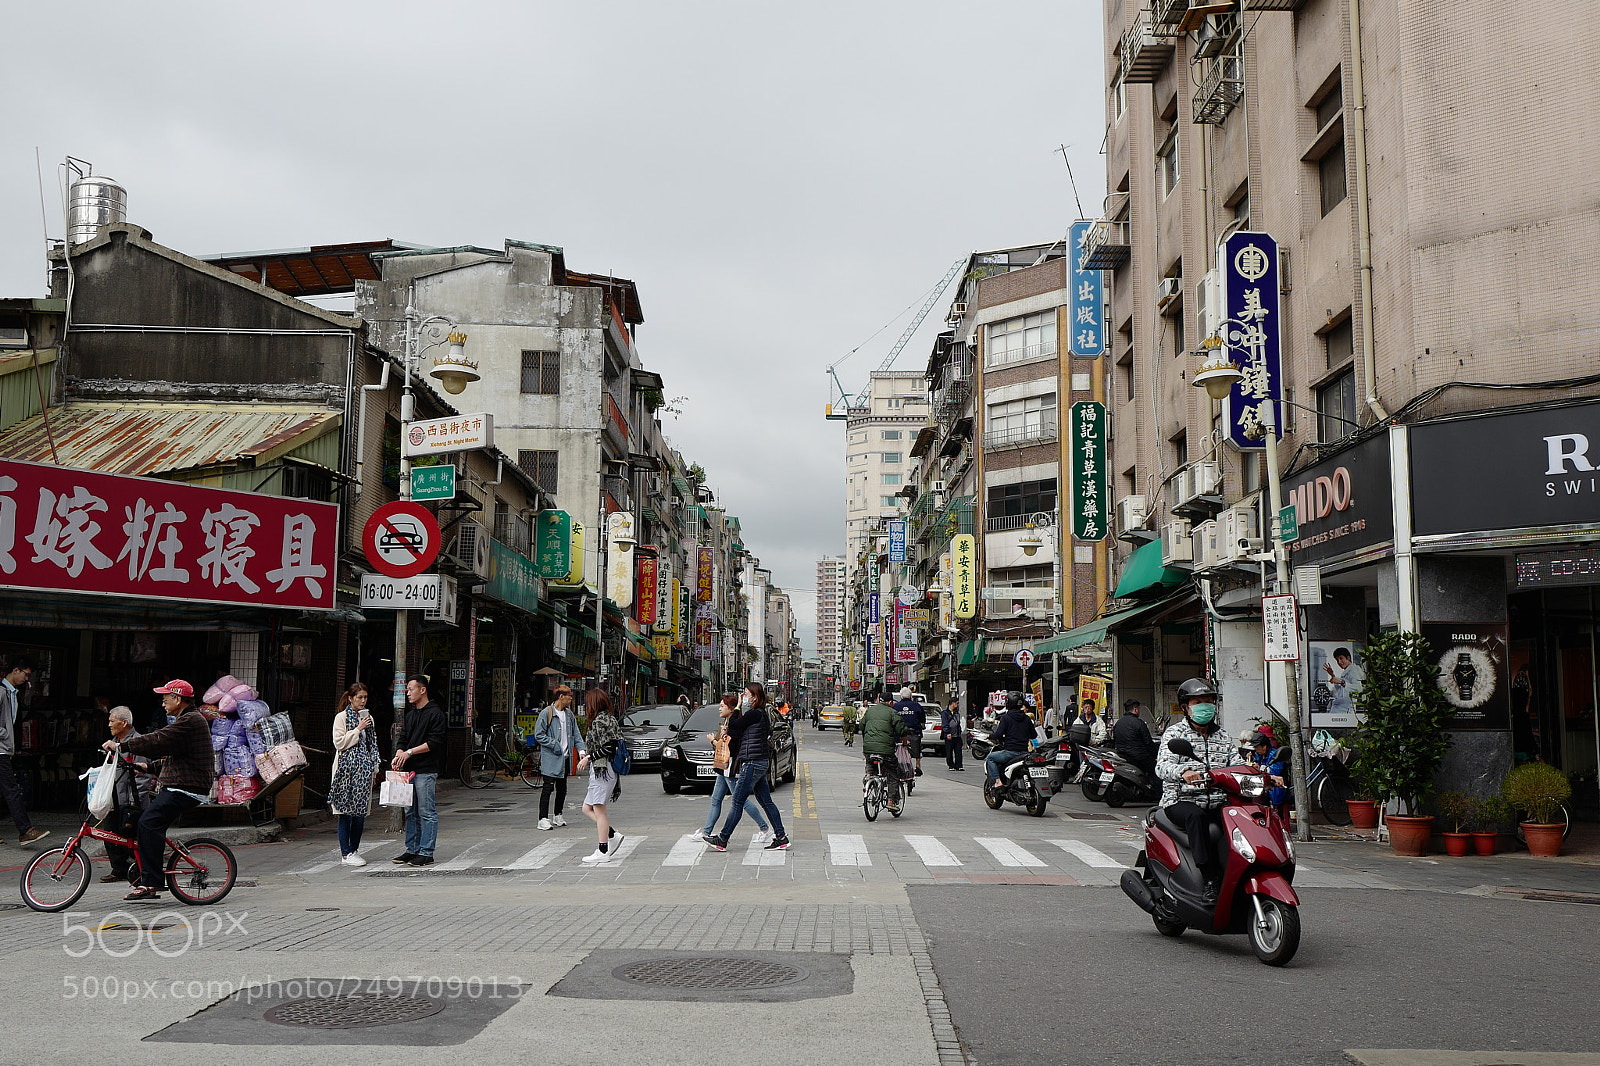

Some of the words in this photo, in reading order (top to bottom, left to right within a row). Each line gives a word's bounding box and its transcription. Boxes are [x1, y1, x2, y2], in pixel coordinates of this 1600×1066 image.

[427, 418, 482, 436] 西昌街夜市
[1080, 404, 1098, 537] 福記青草漢藥房
[1543, 433, 1600, 475] R
[417, 472, 449, 484] 廣州街
[890, 523, 905, 561] 寵物住宿
[957, 540, 971, 613] 華安青草店
[452, 669, 465, 679] 199
